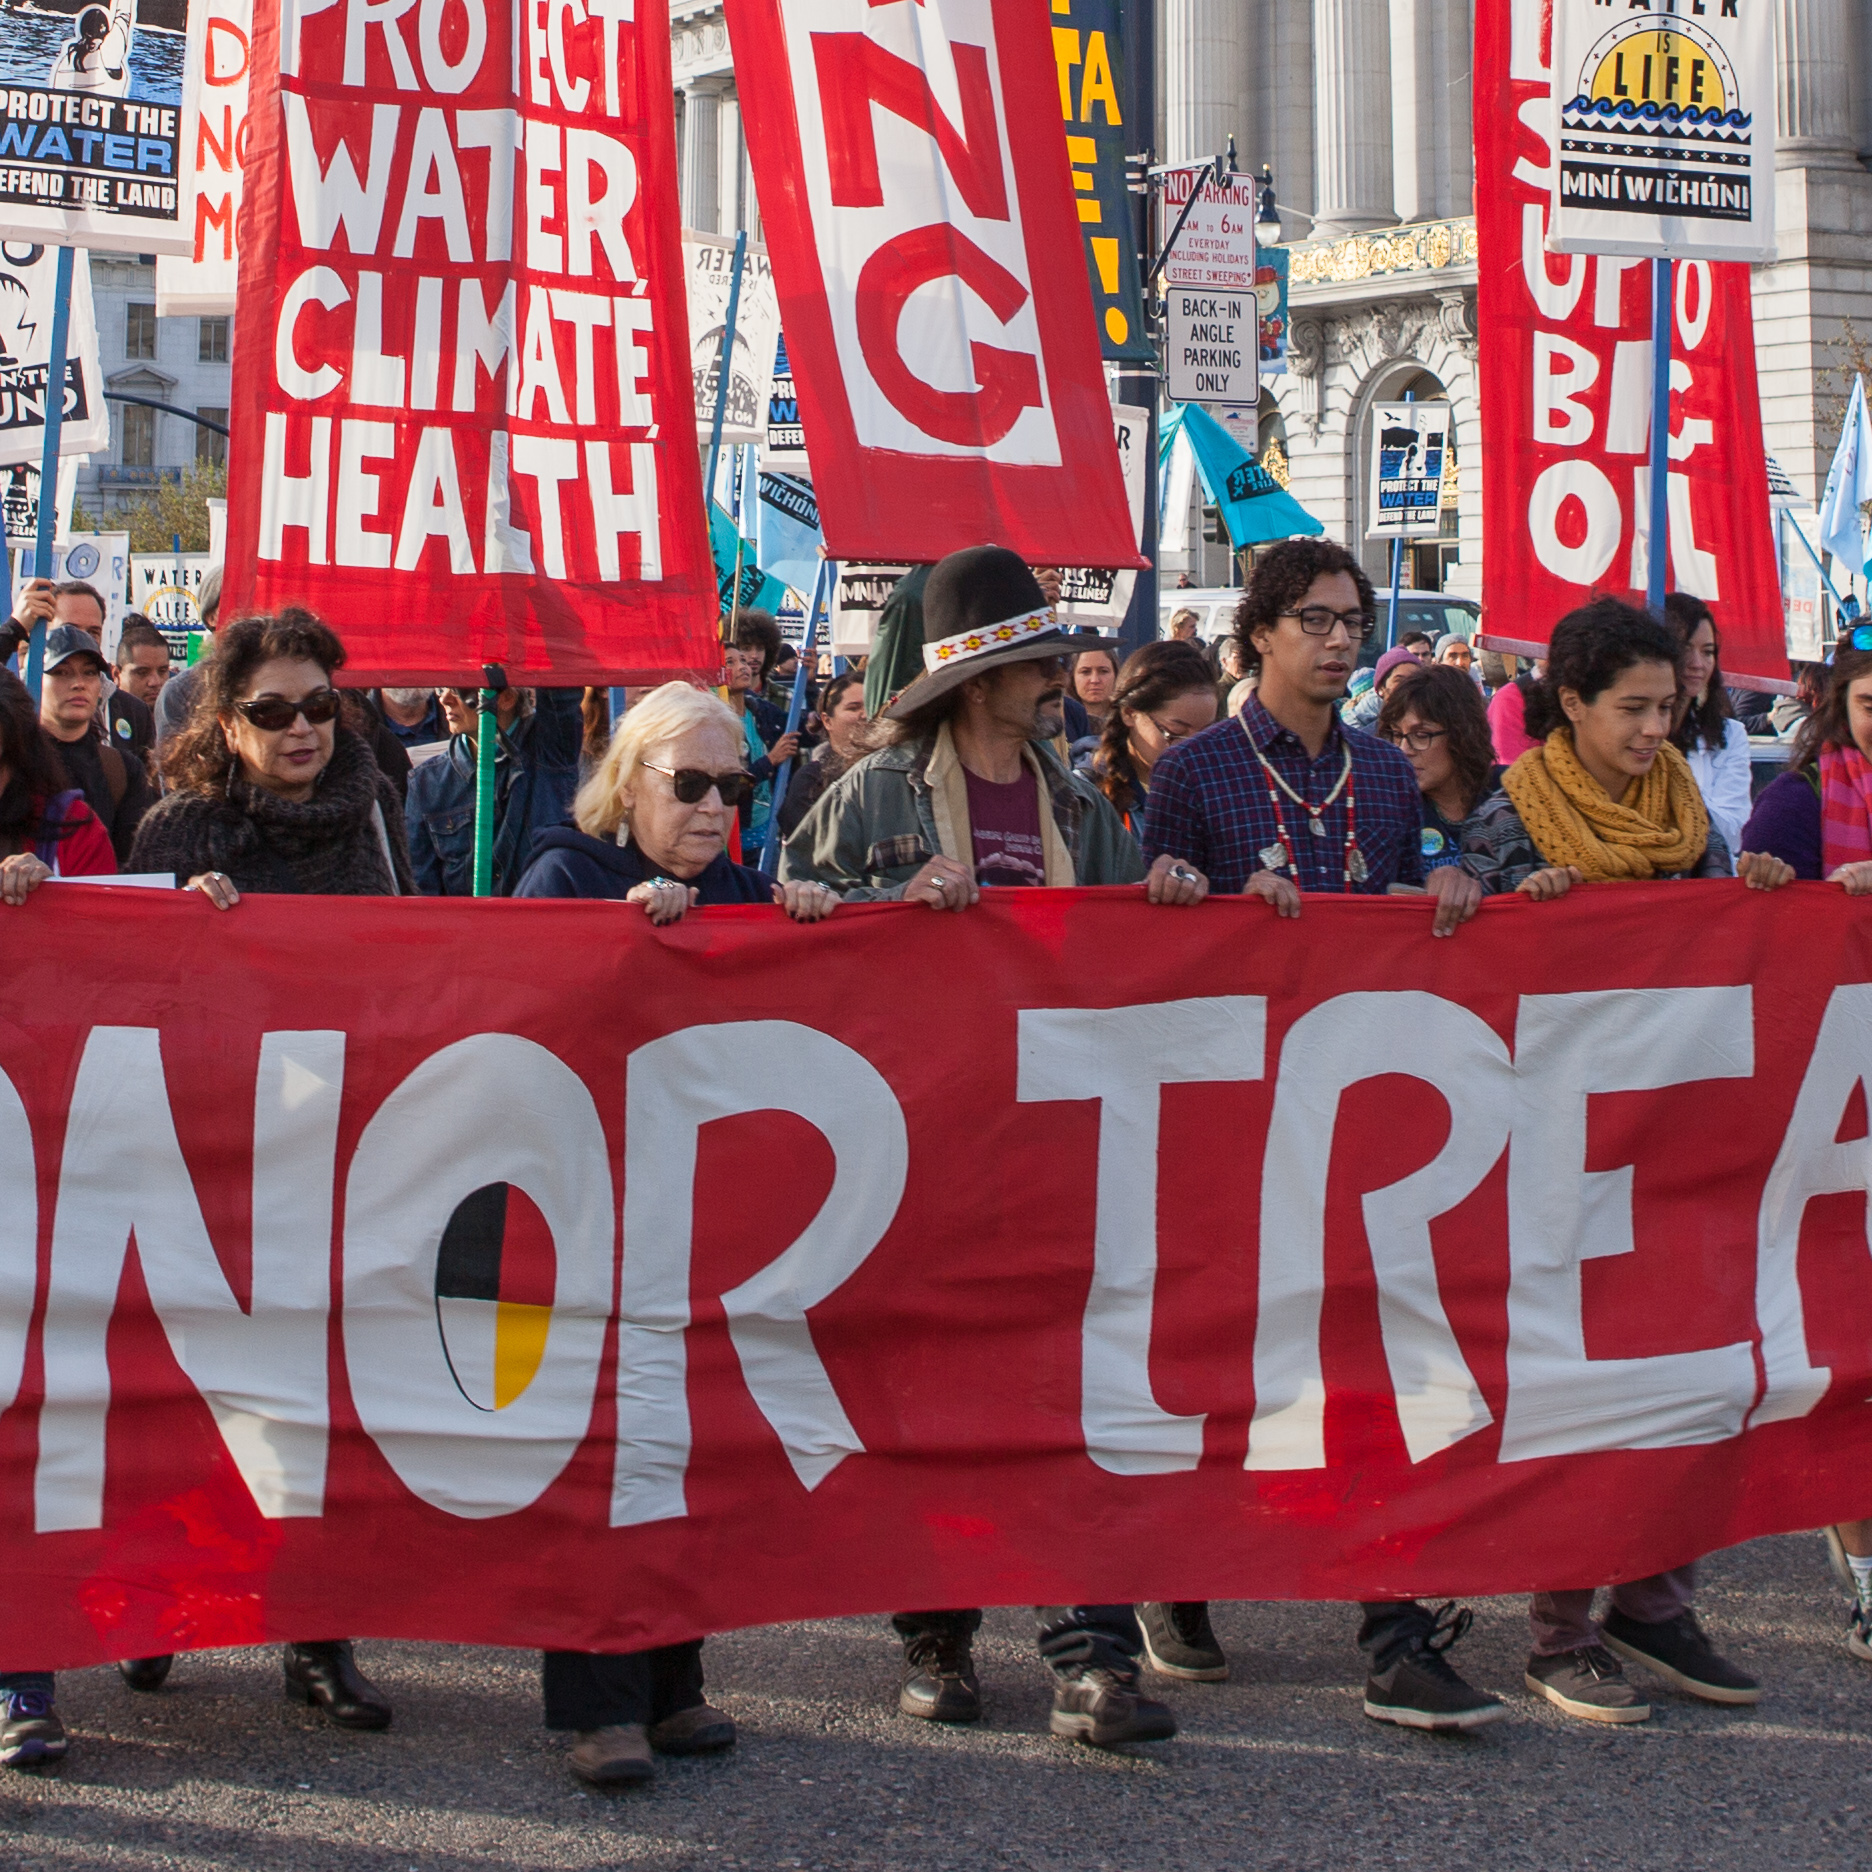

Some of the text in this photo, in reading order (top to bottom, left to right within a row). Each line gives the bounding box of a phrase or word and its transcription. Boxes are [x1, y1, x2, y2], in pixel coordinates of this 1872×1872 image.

[1656, 32, 1671, 54] IS
[1613, 52, 1705, 103] LIFE
[123, 104, 176, 139] THE
[70, 178, 109, 203] THE
[116, 181, 176, 211] LAND
[1168, 172, 1249, 207] NO PARKING
[1561, 168, 1750, 211] MNÍ WIČHÓNI
[1188, 237, 1230, 250] EVERYDAY
[1169, 250, 1249, 265] INCLUDING HOLIDAYS
[1172, 267, 1203, 280] STREET
[1182, 298, 1242, 320] BACK-IN
[1190, 325, 1235, 344] ANGLE
[1183, 348, 1241, 369] PARKING
[1195, 373, 1230, 393] ONLY
[1380, 478, 1438, 493] PROTECT THE
[257, 411, 663, 583] HEALTH
[1380, 492, 1436, 508] WATER
[1528, 459, 1720, 603] OIL
[144, 568, 202, 586] WATER
[155, 601, 190, 619] LIFE
